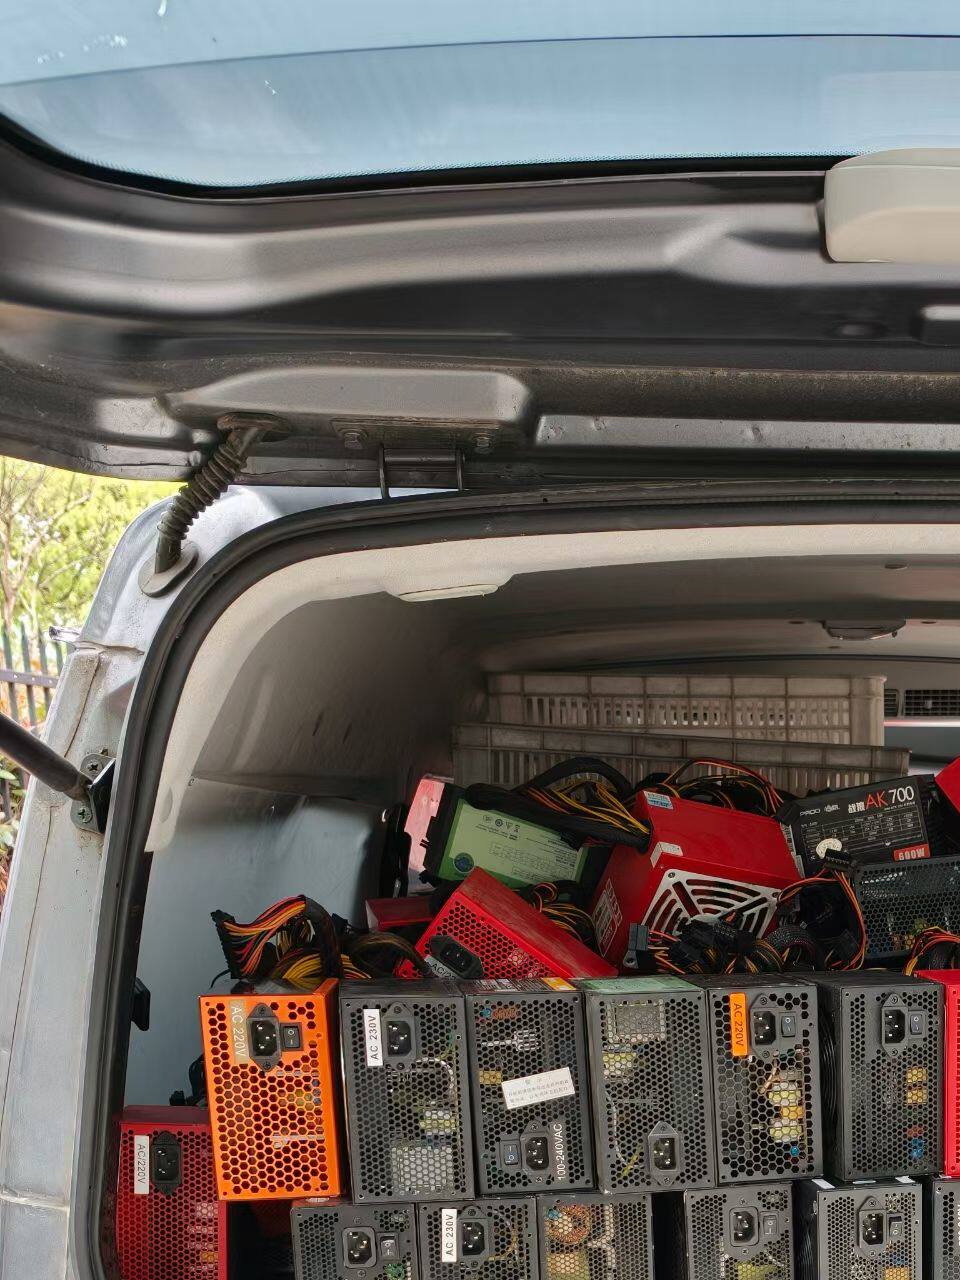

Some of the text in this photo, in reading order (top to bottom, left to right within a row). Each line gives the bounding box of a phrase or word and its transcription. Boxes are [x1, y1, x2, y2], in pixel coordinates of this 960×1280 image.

[232, 1006, 246, 1057] AC 220V
[367, 1016, 379, 1060] AC 230V
[734, 1003, 744, 1047] AC 220V
[137, 1143, 146, 1184] AC/220V
[553, 1123, 566, 1180] 100-240VAC
[446, 1214, 454, 1256] AC 230V
